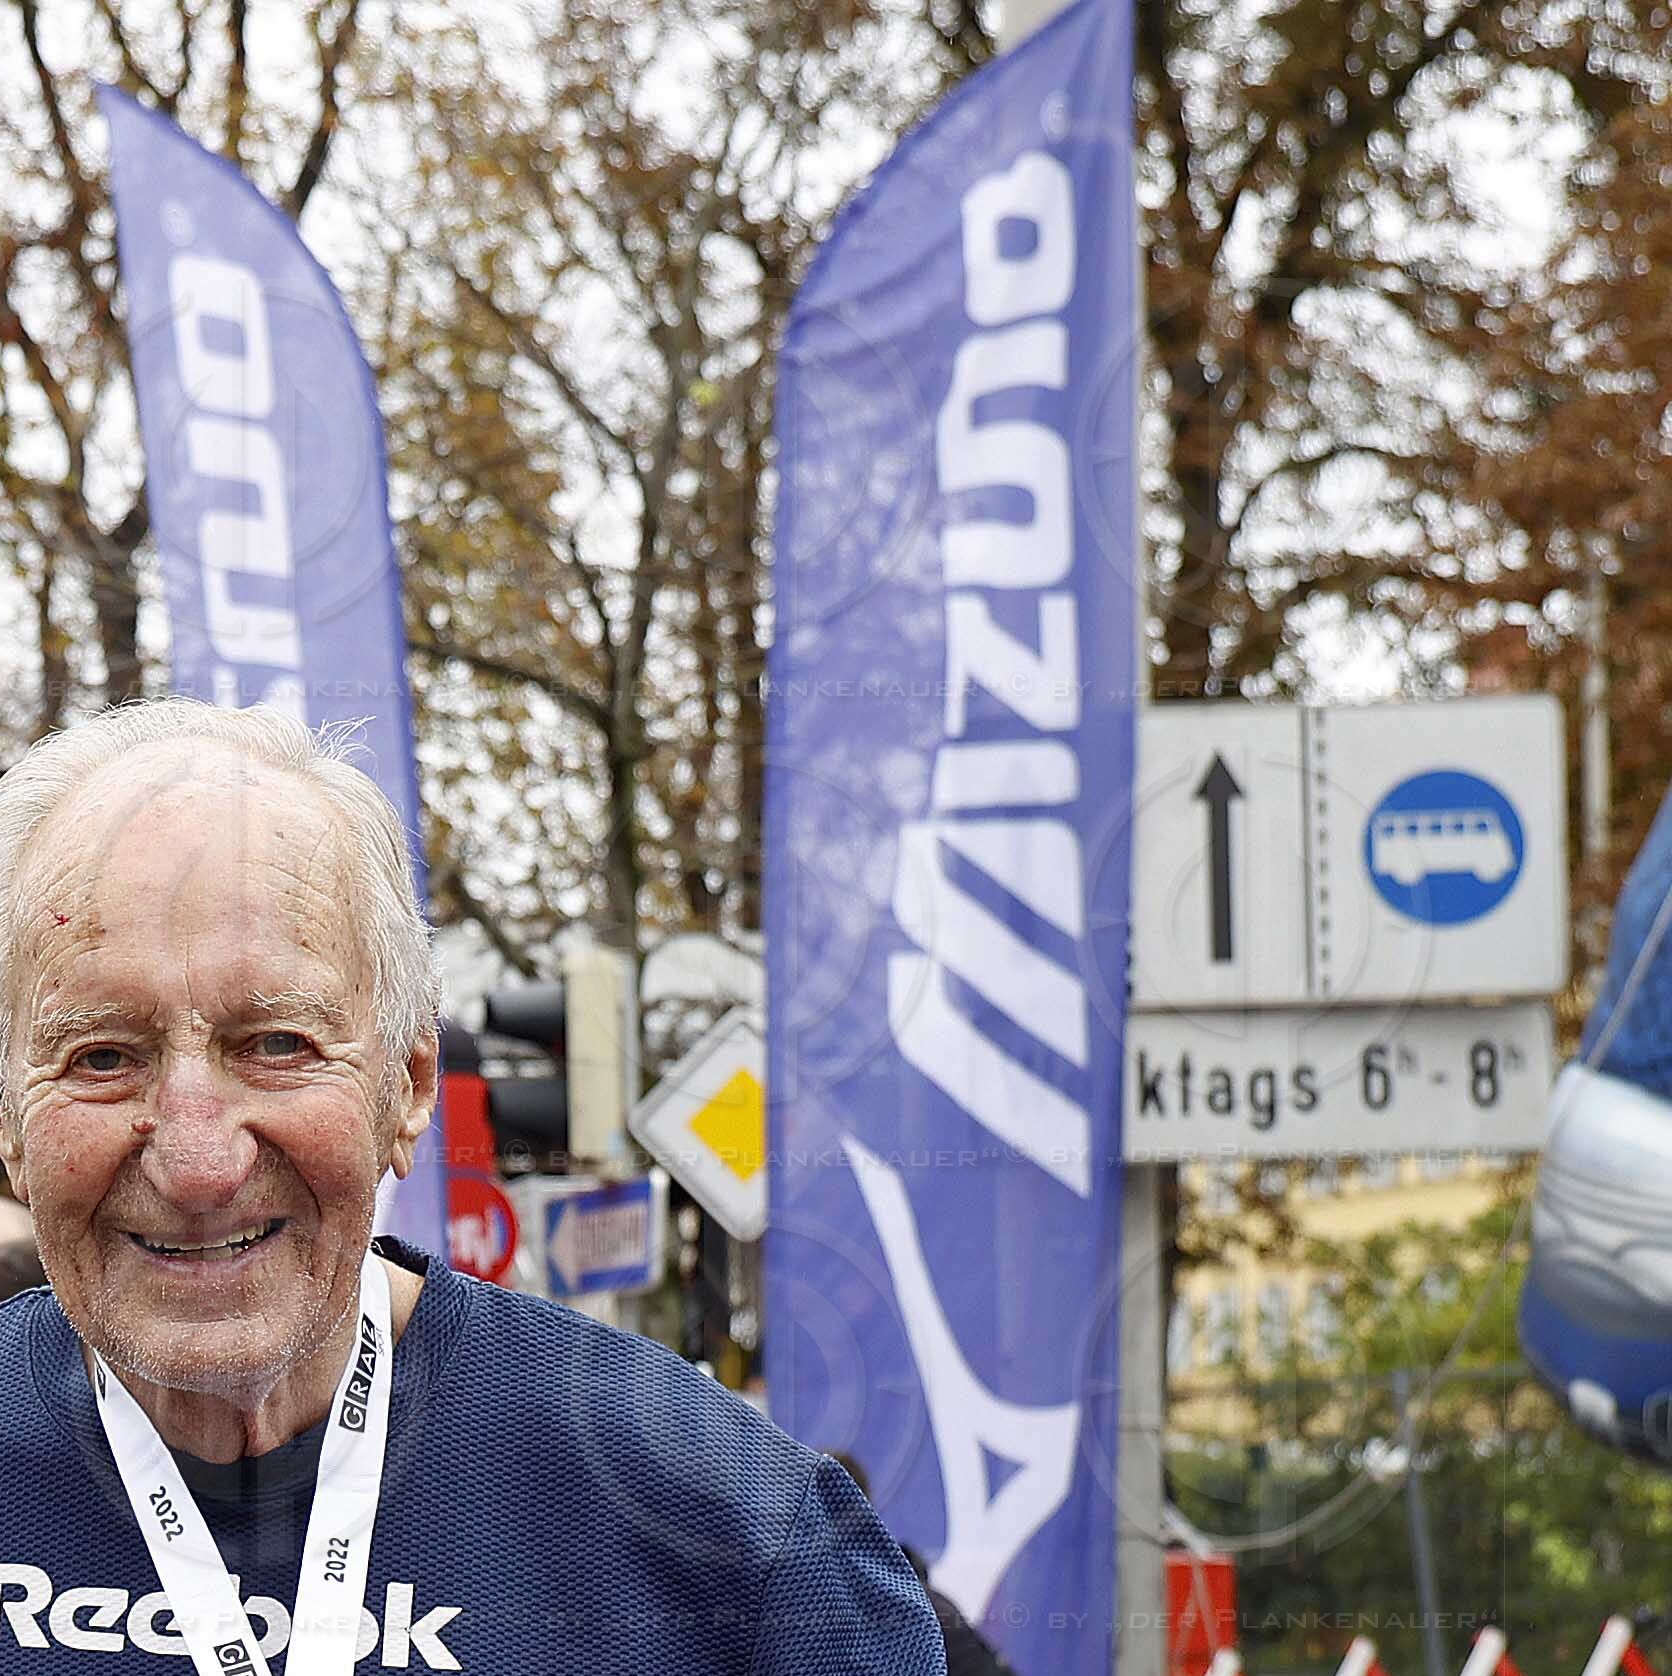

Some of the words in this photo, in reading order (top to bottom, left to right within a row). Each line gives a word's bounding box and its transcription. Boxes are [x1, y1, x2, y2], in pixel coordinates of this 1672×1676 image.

[886, 152, 1090, 1200] MIZUNO
[1136, 1047, 1320, 1130] ktags
[342, 1320, 377, 1430] GRAZ
[148, 1485, 185, 1542] 2022
[323, 1537, 350, 1583] 2022
